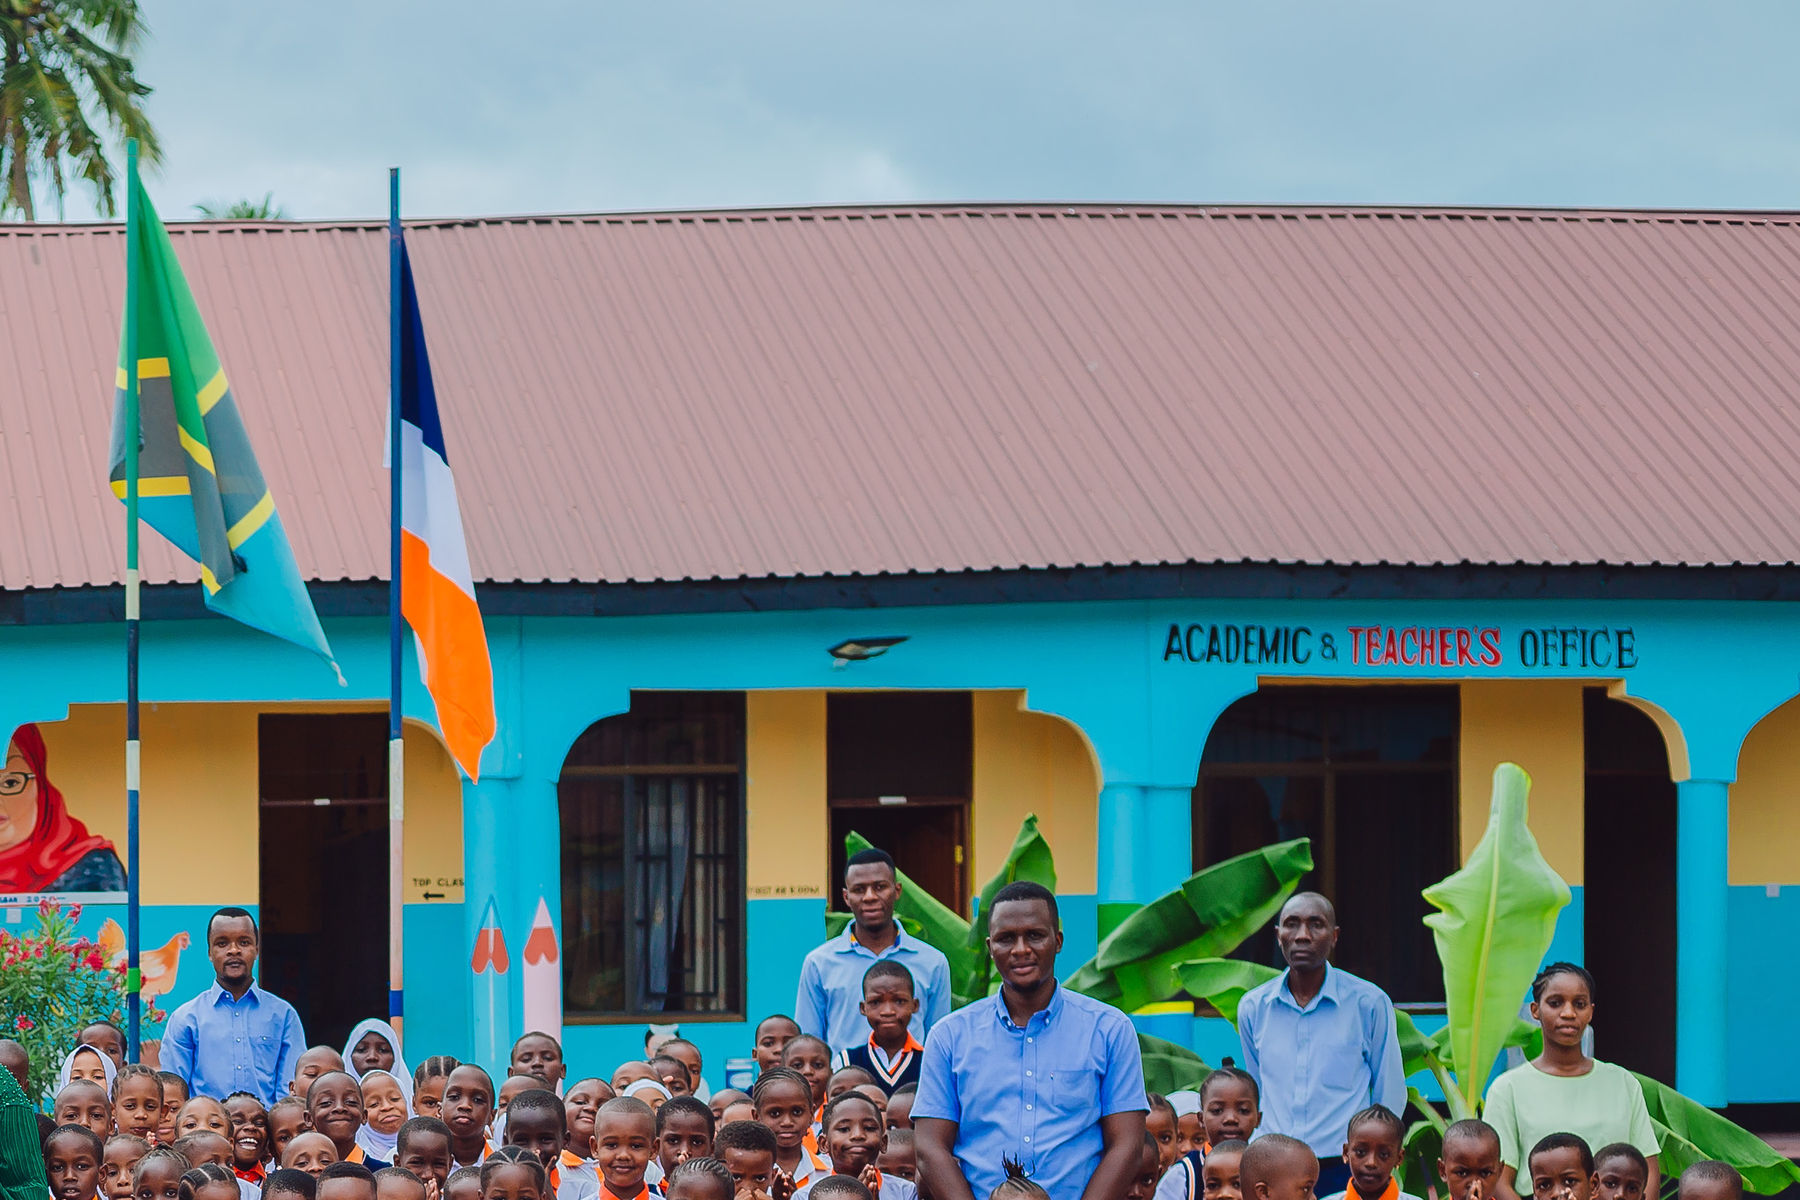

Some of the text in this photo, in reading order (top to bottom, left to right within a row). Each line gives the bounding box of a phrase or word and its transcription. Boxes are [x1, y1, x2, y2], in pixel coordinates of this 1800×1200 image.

[1164, 623, 1639, 669] ACADEMIC & TEACHER'S OFFICE
